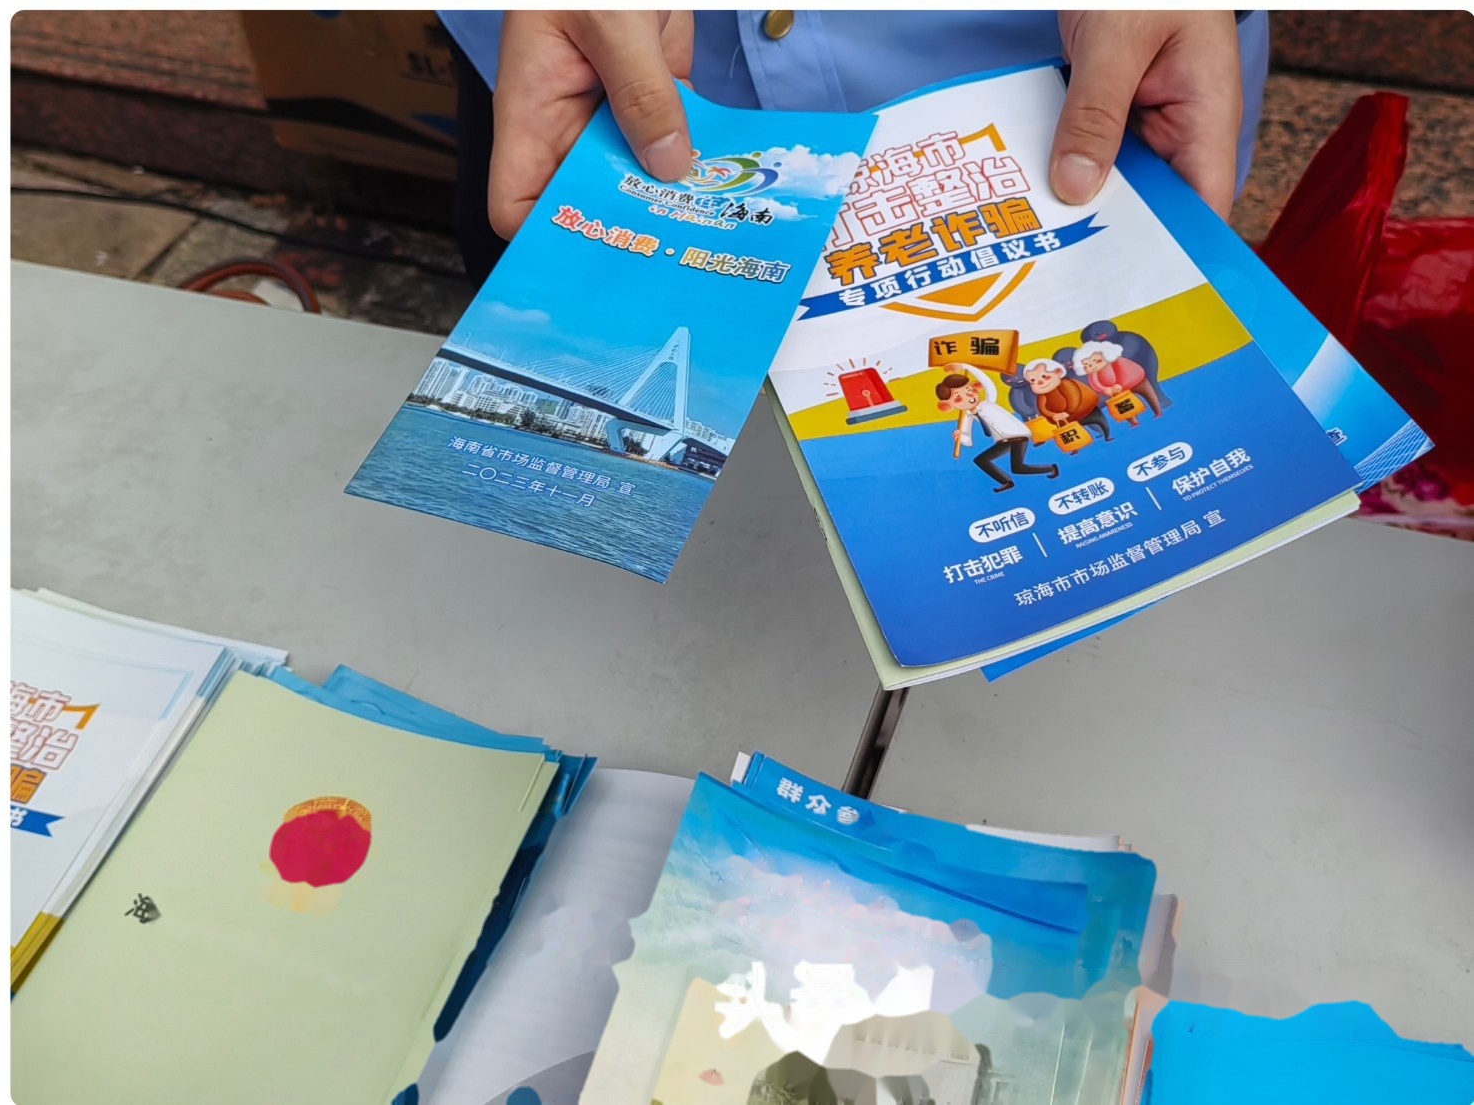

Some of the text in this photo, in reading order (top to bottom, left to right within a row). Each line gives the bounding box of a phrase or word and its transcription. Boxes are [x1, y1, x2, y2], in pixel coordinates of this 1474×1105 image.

[825, 196, 1043, 286] 养老诈骗
[838, 231, 1062, 308] 专项行动倡议书
[447, 435, 611, 490] 海南省市场监督管理局
[975, 445, 1187, 540] 不听信 不转账 不参与
[942, 446, 1252, 585] 打击犯罪 提高意识 保护自我
[1013, 521, 1202, 608] 琼海市市场监督管理局
